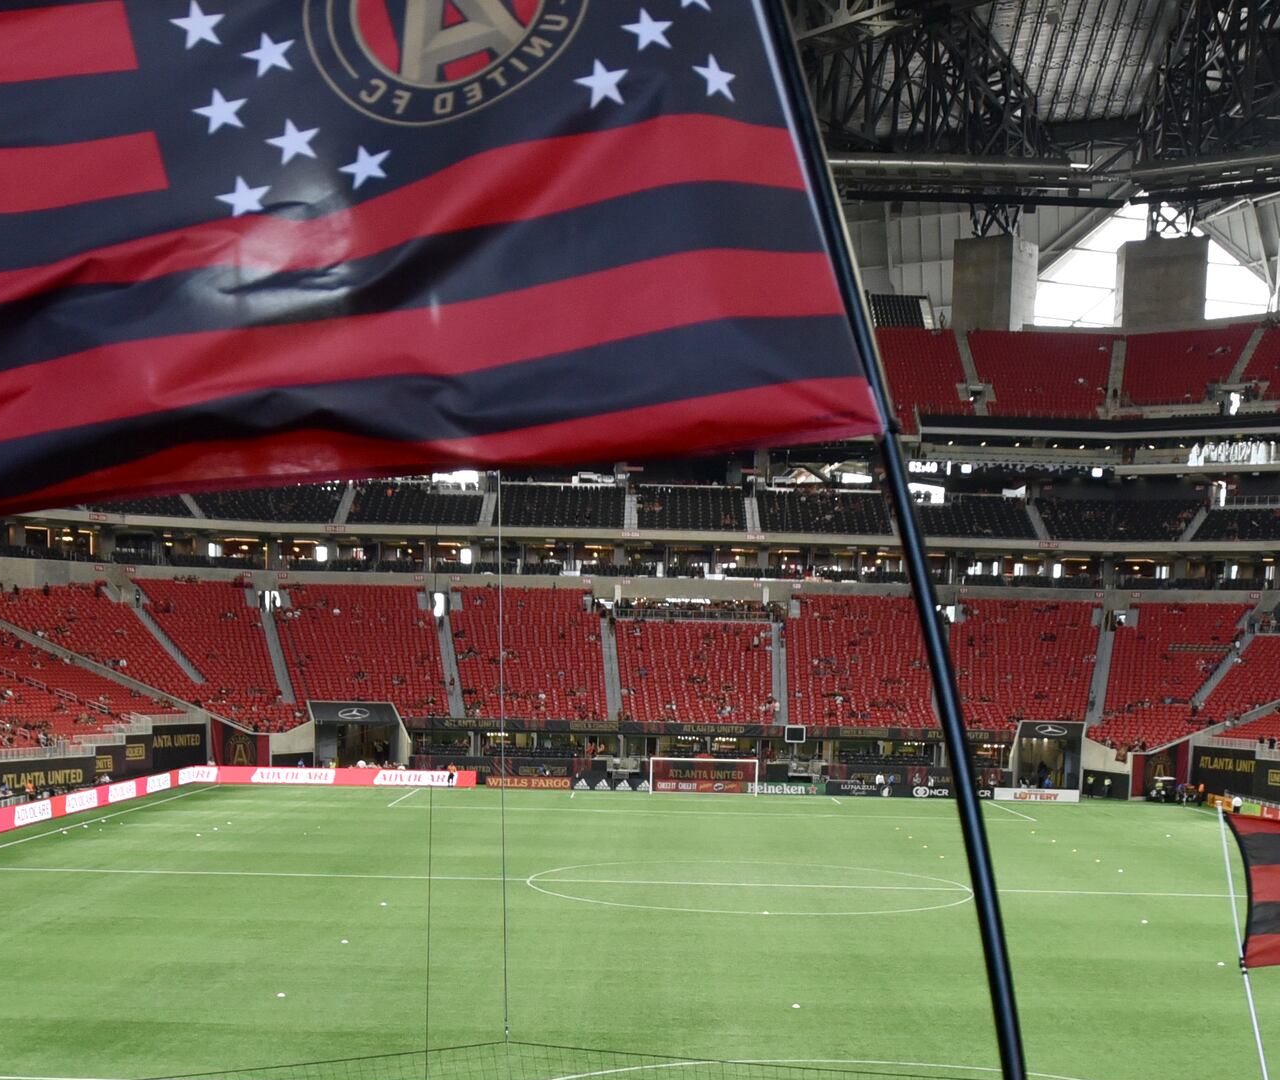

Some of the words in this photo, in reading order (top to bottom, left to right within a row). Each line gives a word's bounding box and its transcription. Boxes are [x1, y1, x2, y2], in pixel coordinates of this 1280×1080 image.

[683, 725, 716, 734] ATLANTA
[717, 726, 745, 734] UNITED
[152, 734, 172, 748] ANTA
[174, 733, 201, 747] UNITED
[96, 757, 112, 770] NITE
[1199, 755, 1234, 772] ATLANTA
[1236, 758, 1255, 773] UNIT
[2, 771, 46, 789] ATLANTA
[47, 767, 83, 786] UNITED
[669, 769, 708, 779] ATLANTA
[709, 769, 744, 780] UNITED
[488, 778, 528, 788] WELLS
[531, 778, 570, 788] FARGO
[748, 782, 806, 795] Heineken
[929, 788, 949, 797] NCR
[978, 789, 991, 797] CR
[1013, 791, 1059, 800] LOTTERY
